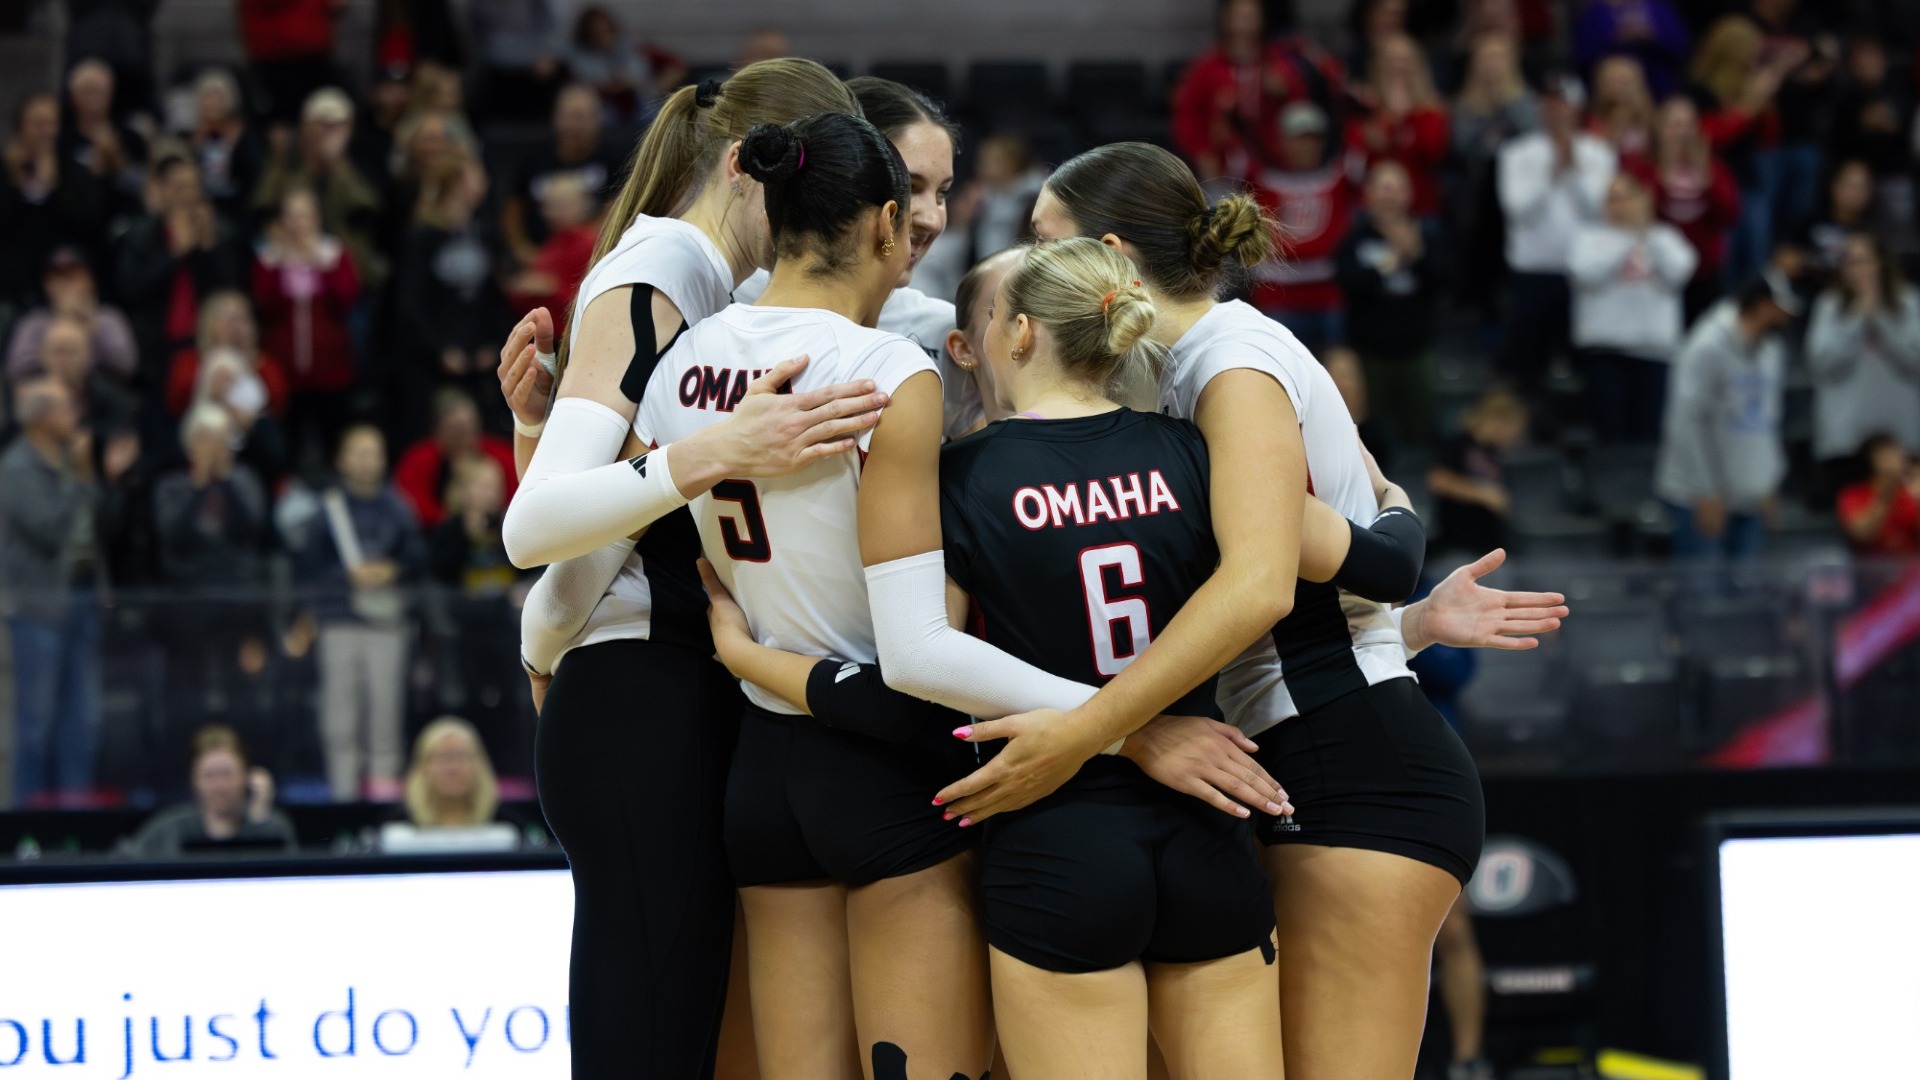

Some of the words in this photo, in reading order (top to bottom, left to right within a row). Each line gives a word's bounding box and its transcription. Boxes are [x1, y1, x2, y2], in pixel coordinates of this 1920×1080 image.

[678, 365, 793, 412] OMA
[1012, 469, 1181, 531] OMAHA
[1078, 541, 1153, 679] 6
[116, 991, 281, 1080] just
[313, 986, 418, 1057] do
[450, 1004, 571, 1069] yo
